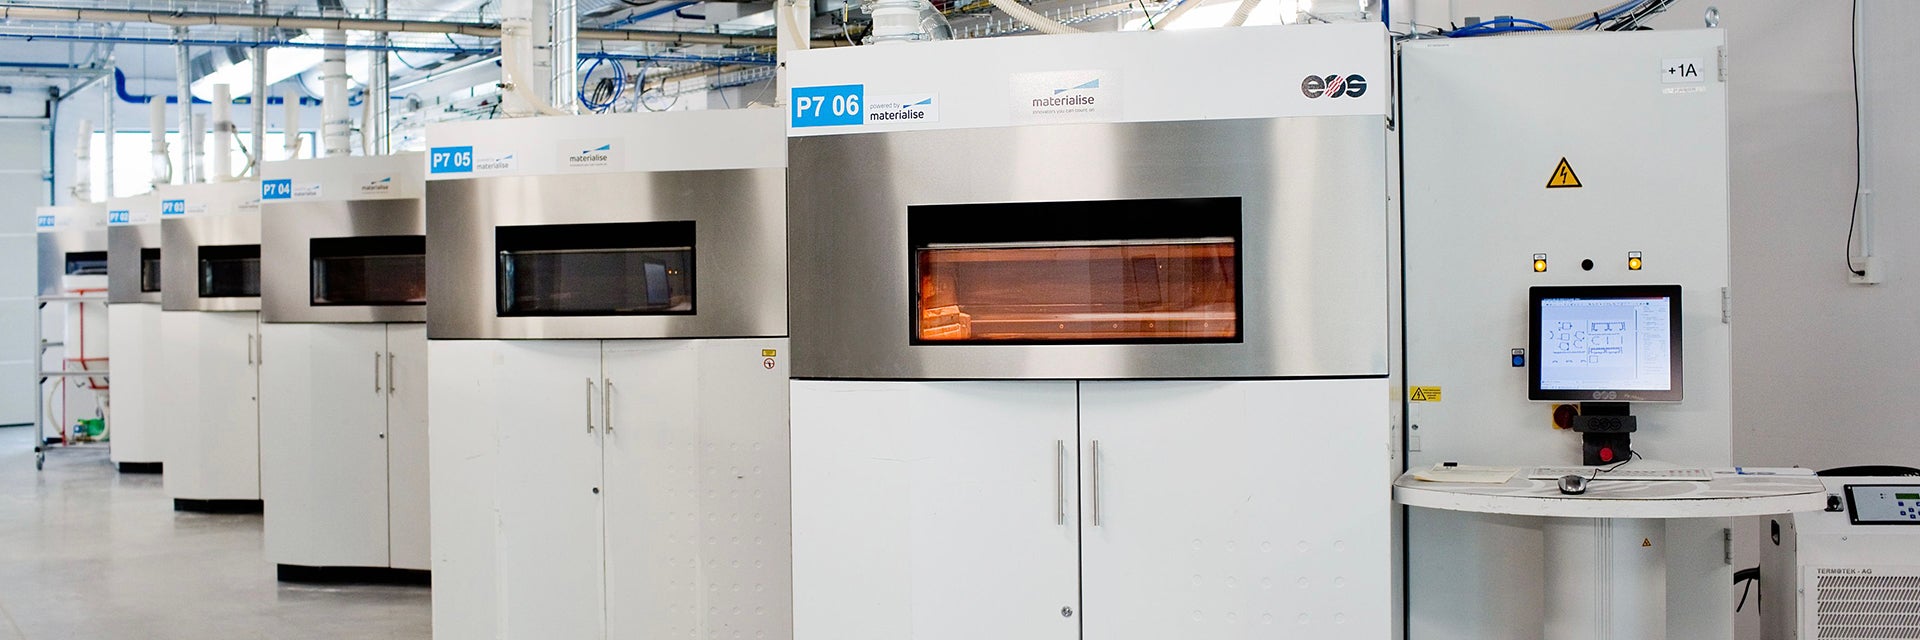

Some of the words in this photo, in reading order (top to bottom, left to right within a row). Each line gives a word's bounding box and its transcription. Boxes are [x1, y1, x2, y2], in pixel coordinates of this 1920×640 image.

[796, 96, 825, 118] P7
[832, 94, 859, 117] 06
[869, 102, 892, 110] powered
[1032, 94, 1095, 107] materialise
[870, 109, 925, 121] materialise
[433, 153, 451, 168] P7
[454, 152, 471, 166] 05
[569, 154, 608, 163] materialise
[476, 162, 509, 170] materialise
[263, 184, 276, 196] P7
[278, 183, 290, 195] 04
